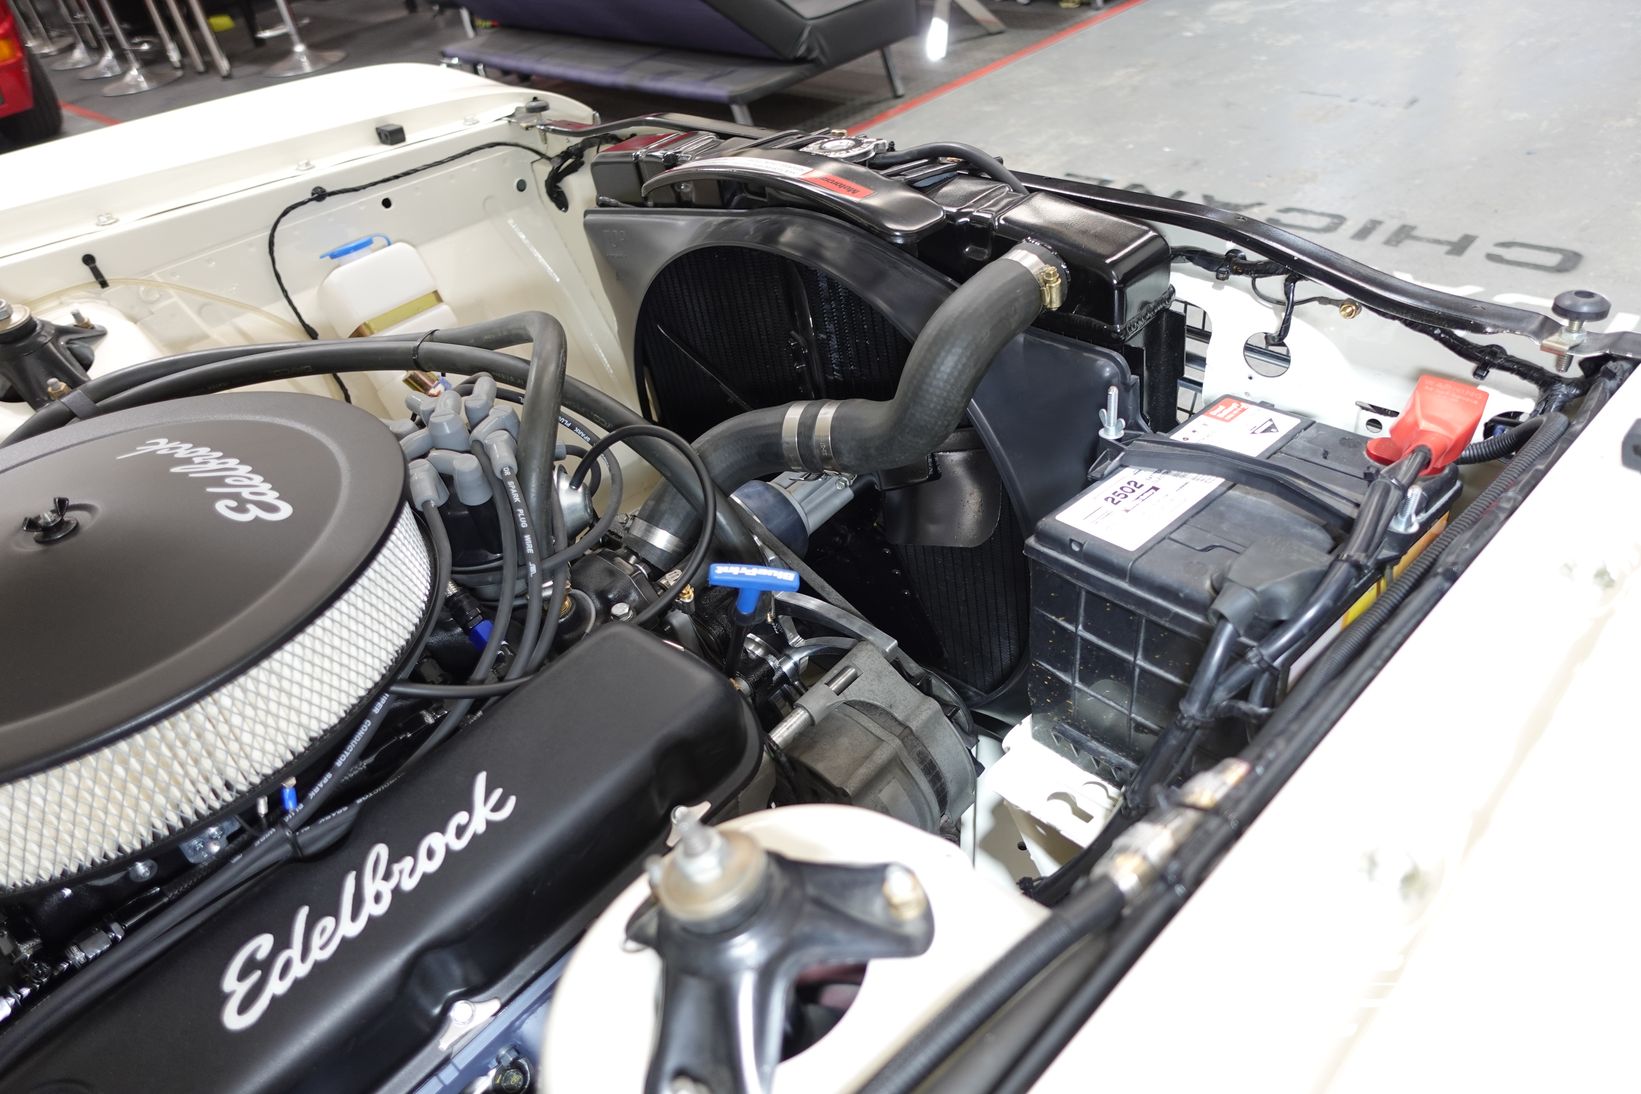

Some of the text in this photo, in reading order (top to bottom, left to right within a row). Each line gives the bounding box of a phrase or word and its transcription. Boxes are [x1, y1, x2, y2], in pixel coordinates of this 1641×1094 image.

[573, 426, 591, 443] SPARK
[116, 438, 293, 522] Edelbrock
[1104, 480, 1145, 506] 2502
[507, 480, 521, 503] SPARK
[517, 508, 528, 529] PLUG
[524, 534, 534, 554] WIRE
[371, 692, 390, 714] UPER
[336, 719, 372, 767] CONDUCTOR
[308, 772, 333, 800] SPARK
[220, 770, 517, 1031] Edelbrock
